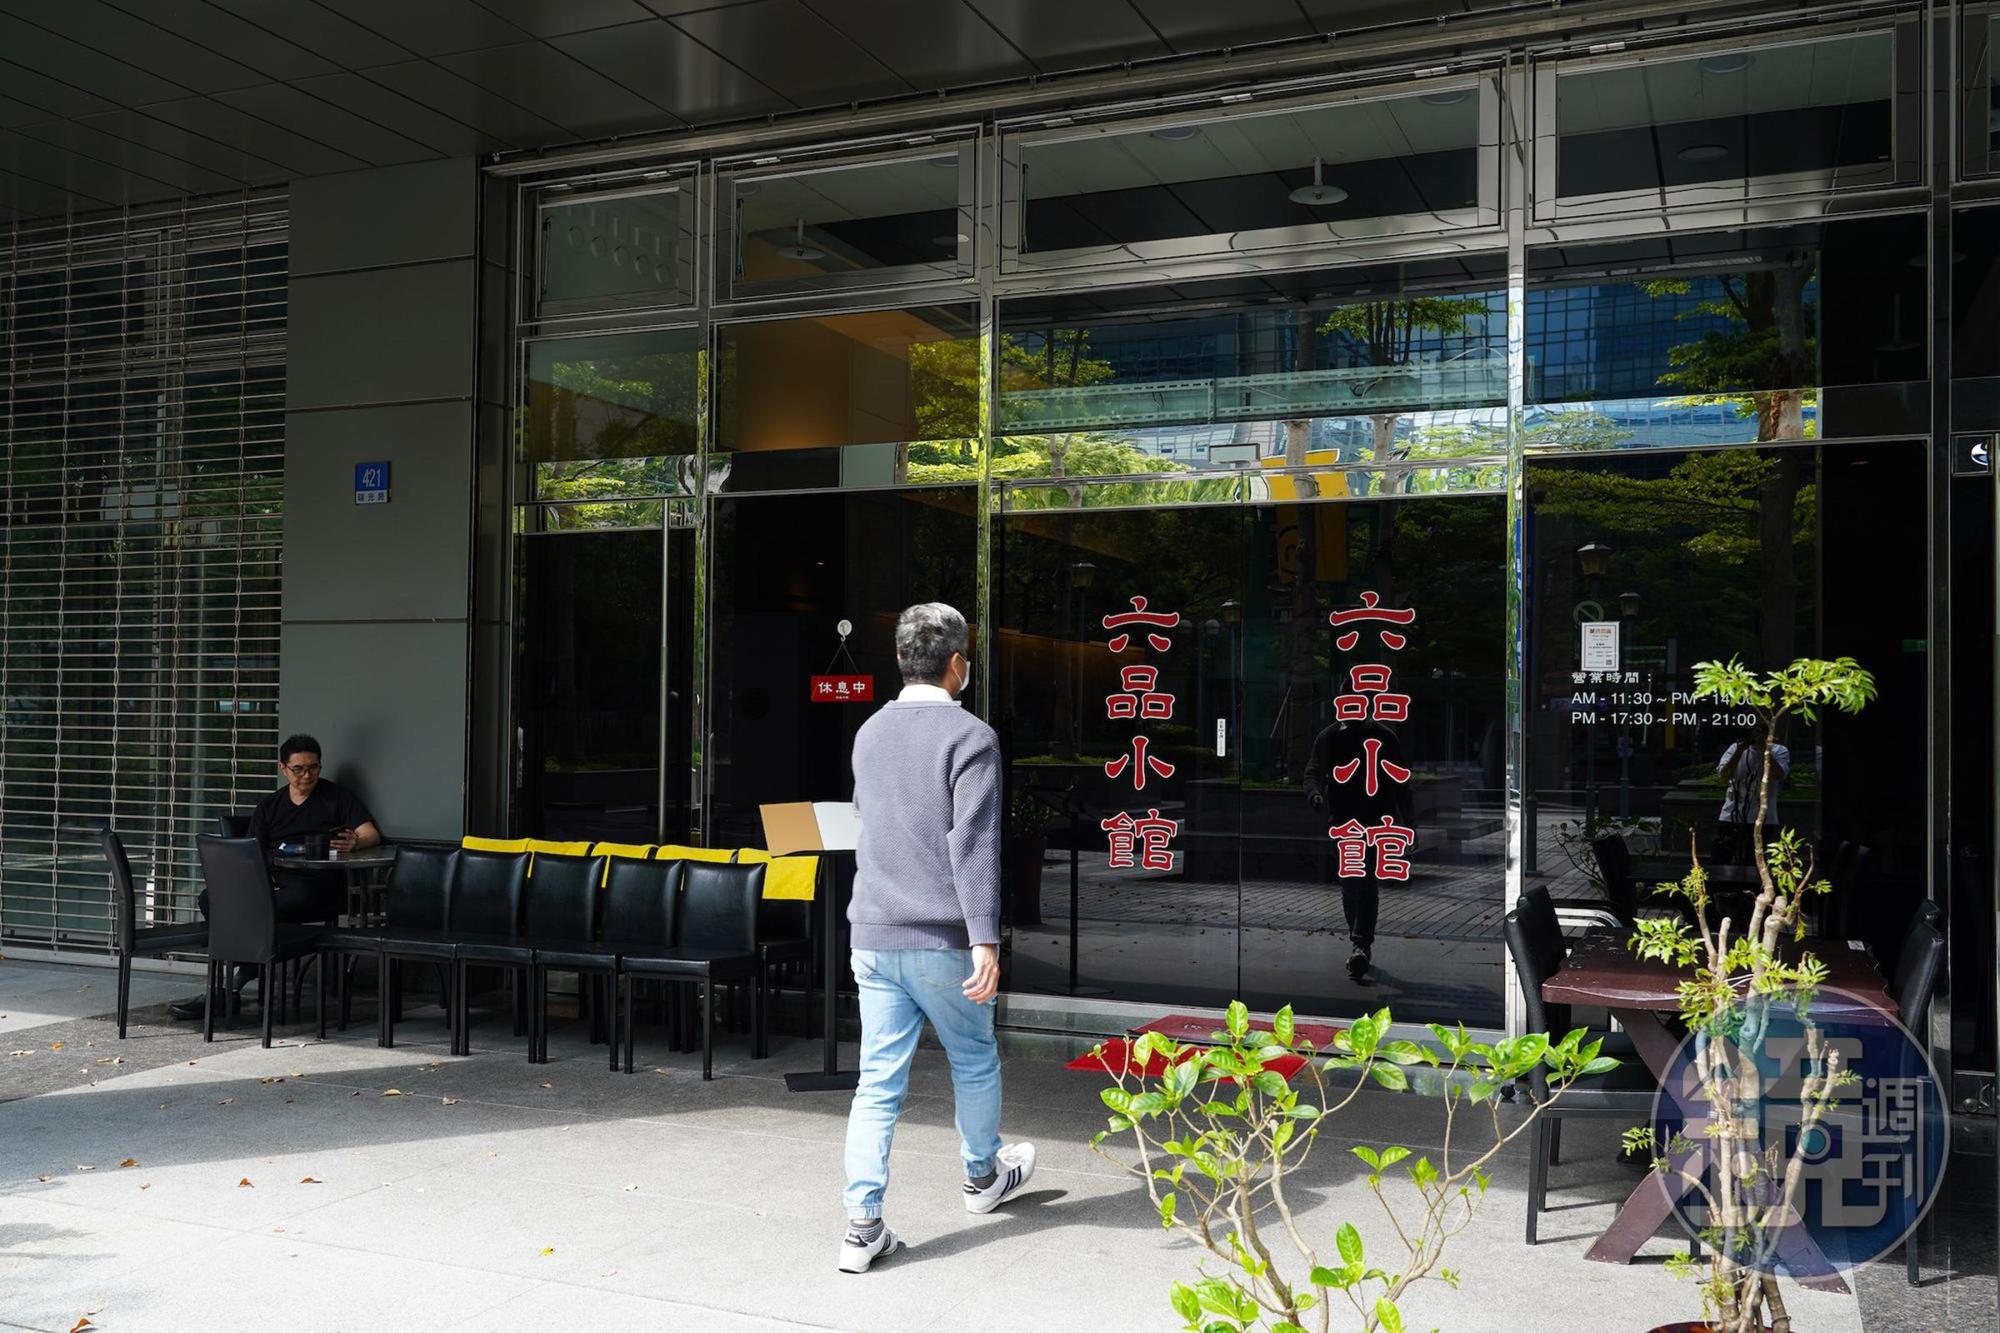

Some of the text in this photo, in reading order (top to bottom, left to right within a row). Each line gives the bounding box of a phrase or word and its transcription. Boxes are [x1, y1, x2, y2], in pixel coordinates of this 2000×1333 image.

[362, 468, 380, 487] 421
[818, 681, 865, 694] 休息中
[1571, 691, 1596, 705] AM
[1610, 692, 1653, 705] 11:30
[1671, 692, 1697, 705] PM
[1571, 711, 1596, 725] PM
[1610, 712, 1653, 725] 17:30
[1672, 712, 1697, 726] PM
[1711, 713, 1757, 726] 21:00
[1101, 595, 1180, 871] 六品小館
[1328, 590, 1416, 881] 六品小館
